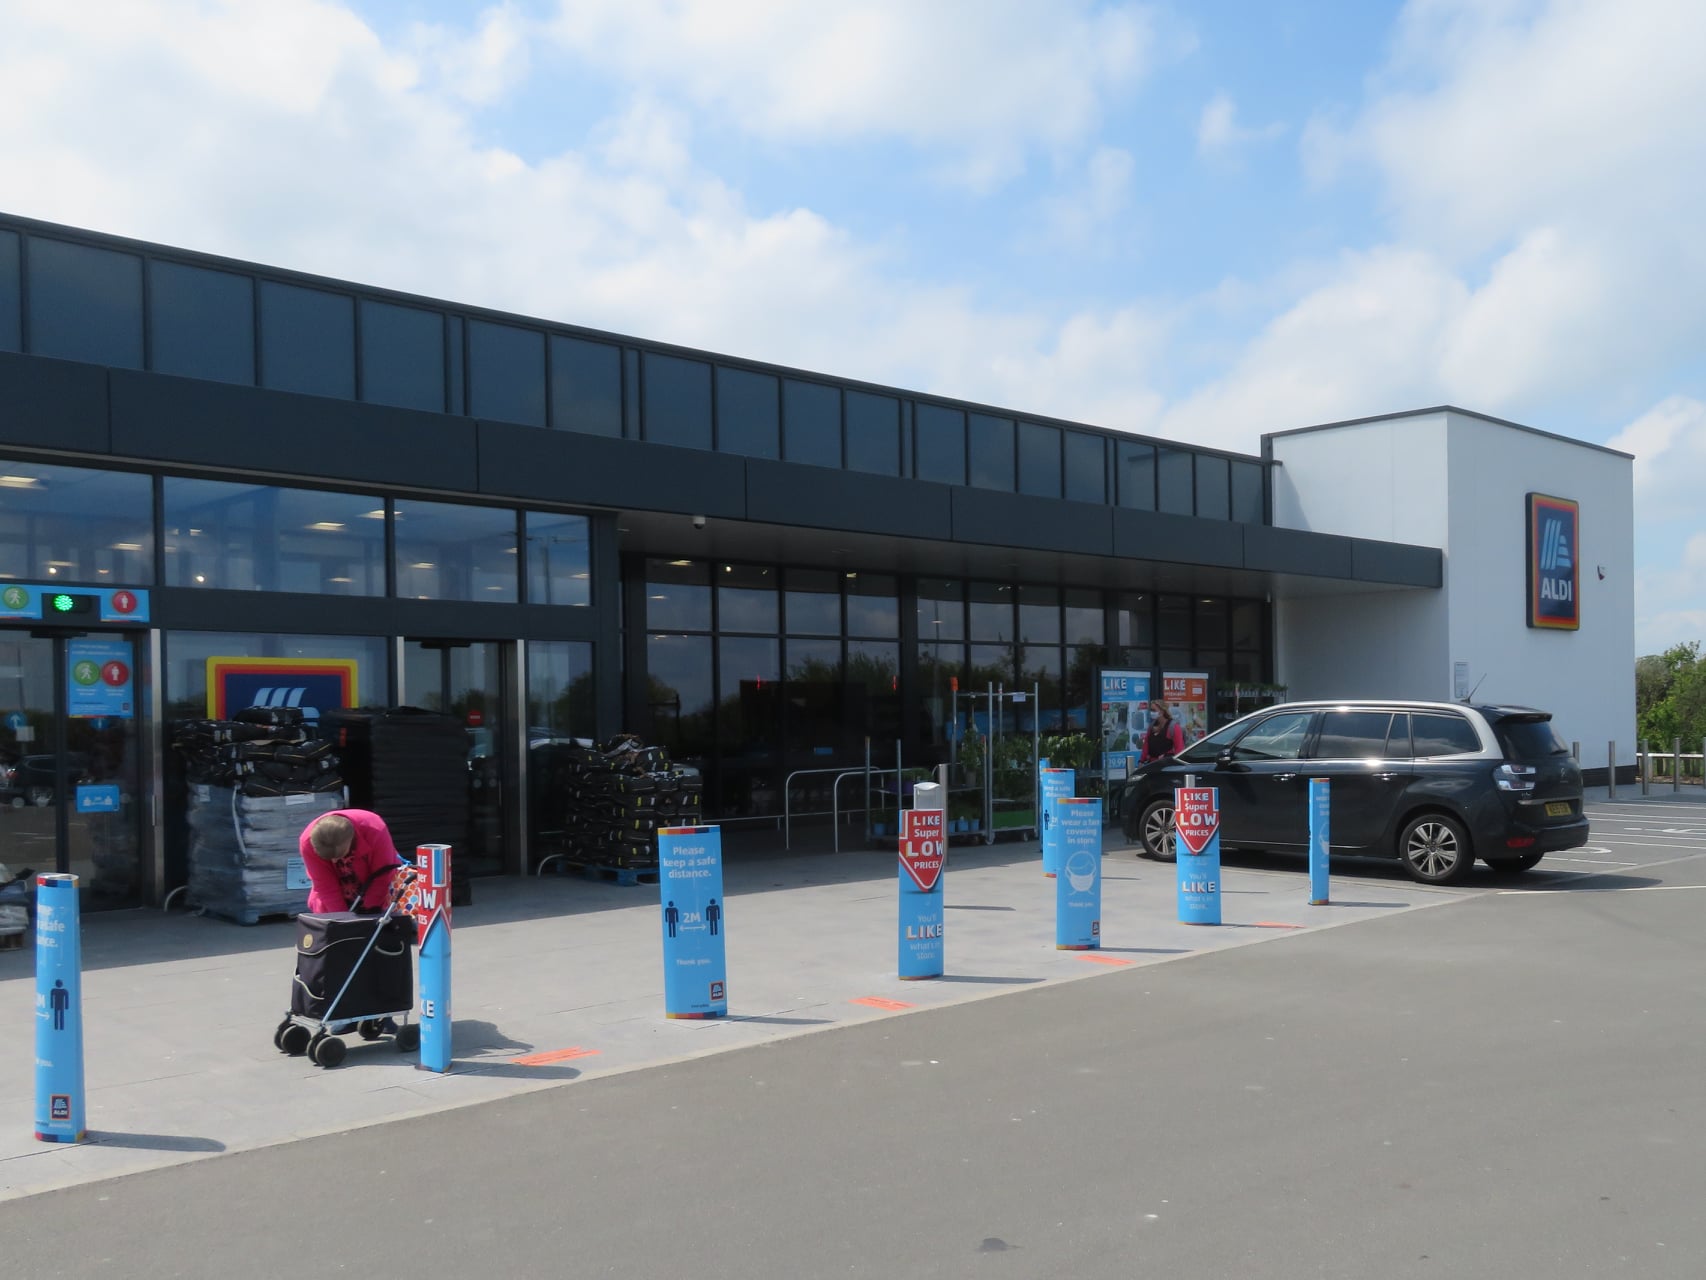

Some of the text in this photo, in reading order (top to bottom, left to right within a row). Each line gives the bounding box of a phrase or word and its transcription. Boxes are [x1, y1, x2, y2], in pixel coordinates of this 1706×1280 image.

[1541, 577, 1572, 601] ALDI
[1104, 679, 1127, 690] LIKE
[1164, 680, 1186, 690] LIKE
[1184, 792, 1209, 801] LIKE
[1185, 803, 1208, 812] Super
[913, 815, 940, 826] LIKE
[1180, 813, 1217, 826] LOW
[914, 829, 940, 839] Super
[1066, 829, 1097, 837] covering
[673, 846, 705, 855] Please
[906, 840, 944, 857] LOW
[663, 857, 686, 868] keep
[697, 856, 717, 866] safe
[914, 861, 940, 869] PRICES
[668, 869, 712, 879] distance.
[1182, 880, 1216, 893] LIKE
[683, 912, 701, 923] 2M
[906, 923, 943, 940] LIKE
